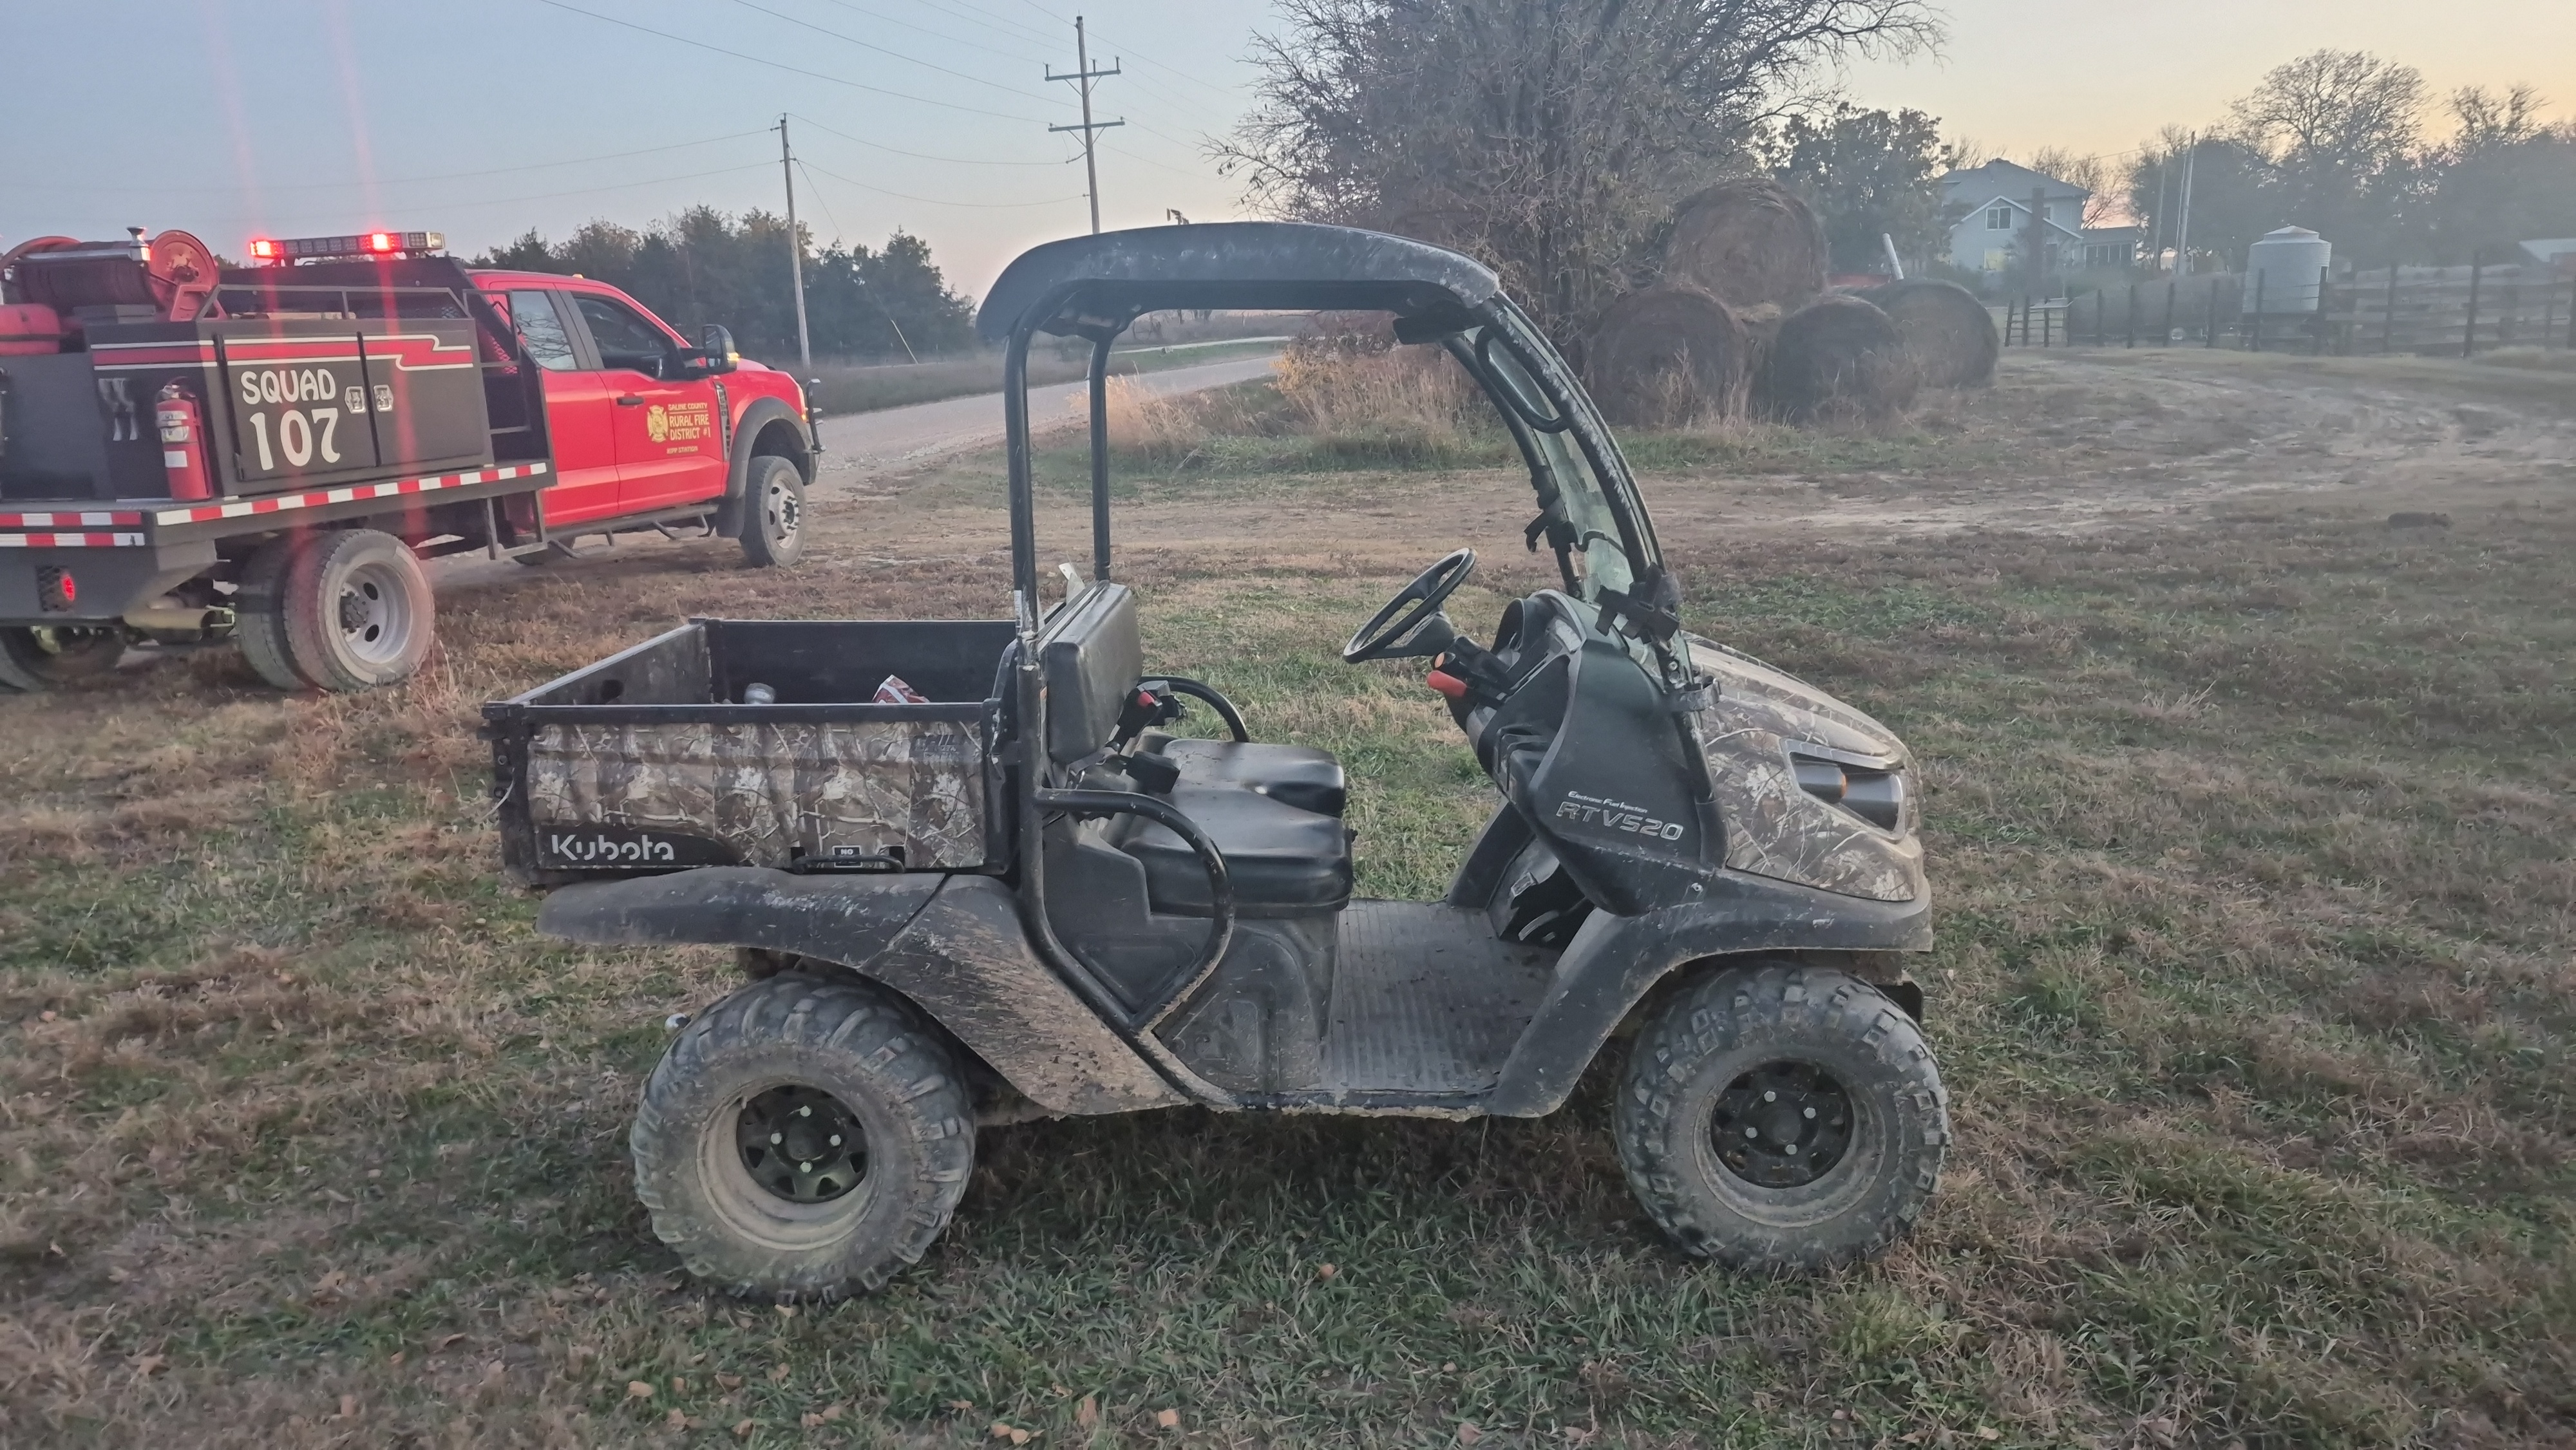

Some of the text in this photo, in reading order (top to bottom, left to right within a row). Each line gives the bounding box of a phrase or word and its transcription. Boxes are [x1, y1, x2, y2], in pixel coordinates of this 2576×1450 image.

[241, 369, 336, 404] SQUAD
[669, 413, 710, 428] RURAL FIRE
[670, 426, 711, 441] DISTRICT #1
[250, 408, 340, 470] 107
[1568, 791, 1603, 804] Electronic
[1556, 801, 1684, 840] RTV520
[551, 834, 674, 861] Kubota
